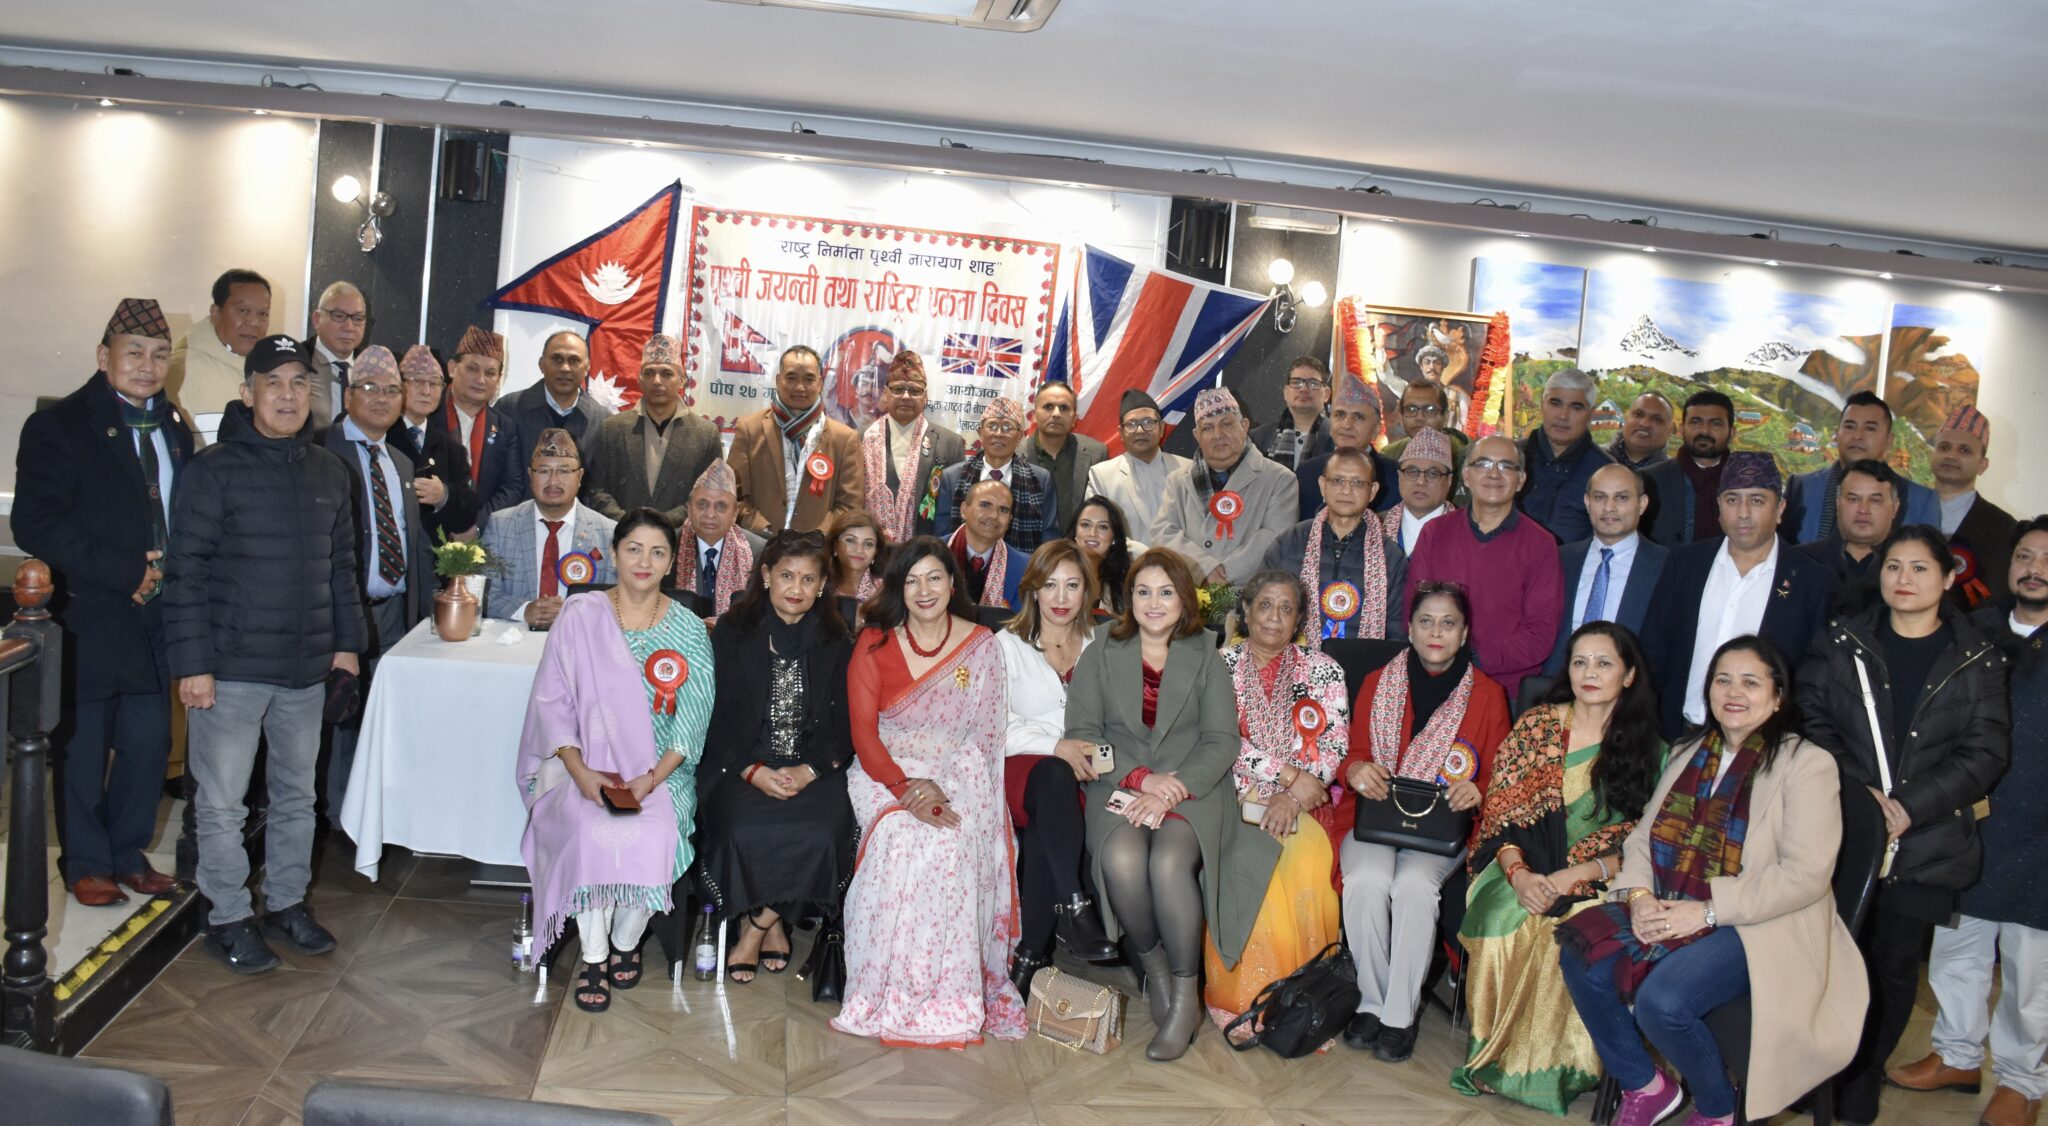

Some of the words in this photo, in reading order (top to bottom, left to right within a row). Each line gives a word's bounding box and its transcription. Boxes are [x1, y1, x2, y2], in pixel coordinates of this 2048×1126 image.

[818, 240, 864, 260] निर्माता
[870, 247, 902, 266] पृथ्वी
[908, 253, 963, 270] नारायण
[756, 264, 819, 305] जयन्ती
[824, 276, 860, 308] तथा
[981, 281, 1028, 328] दिवस
